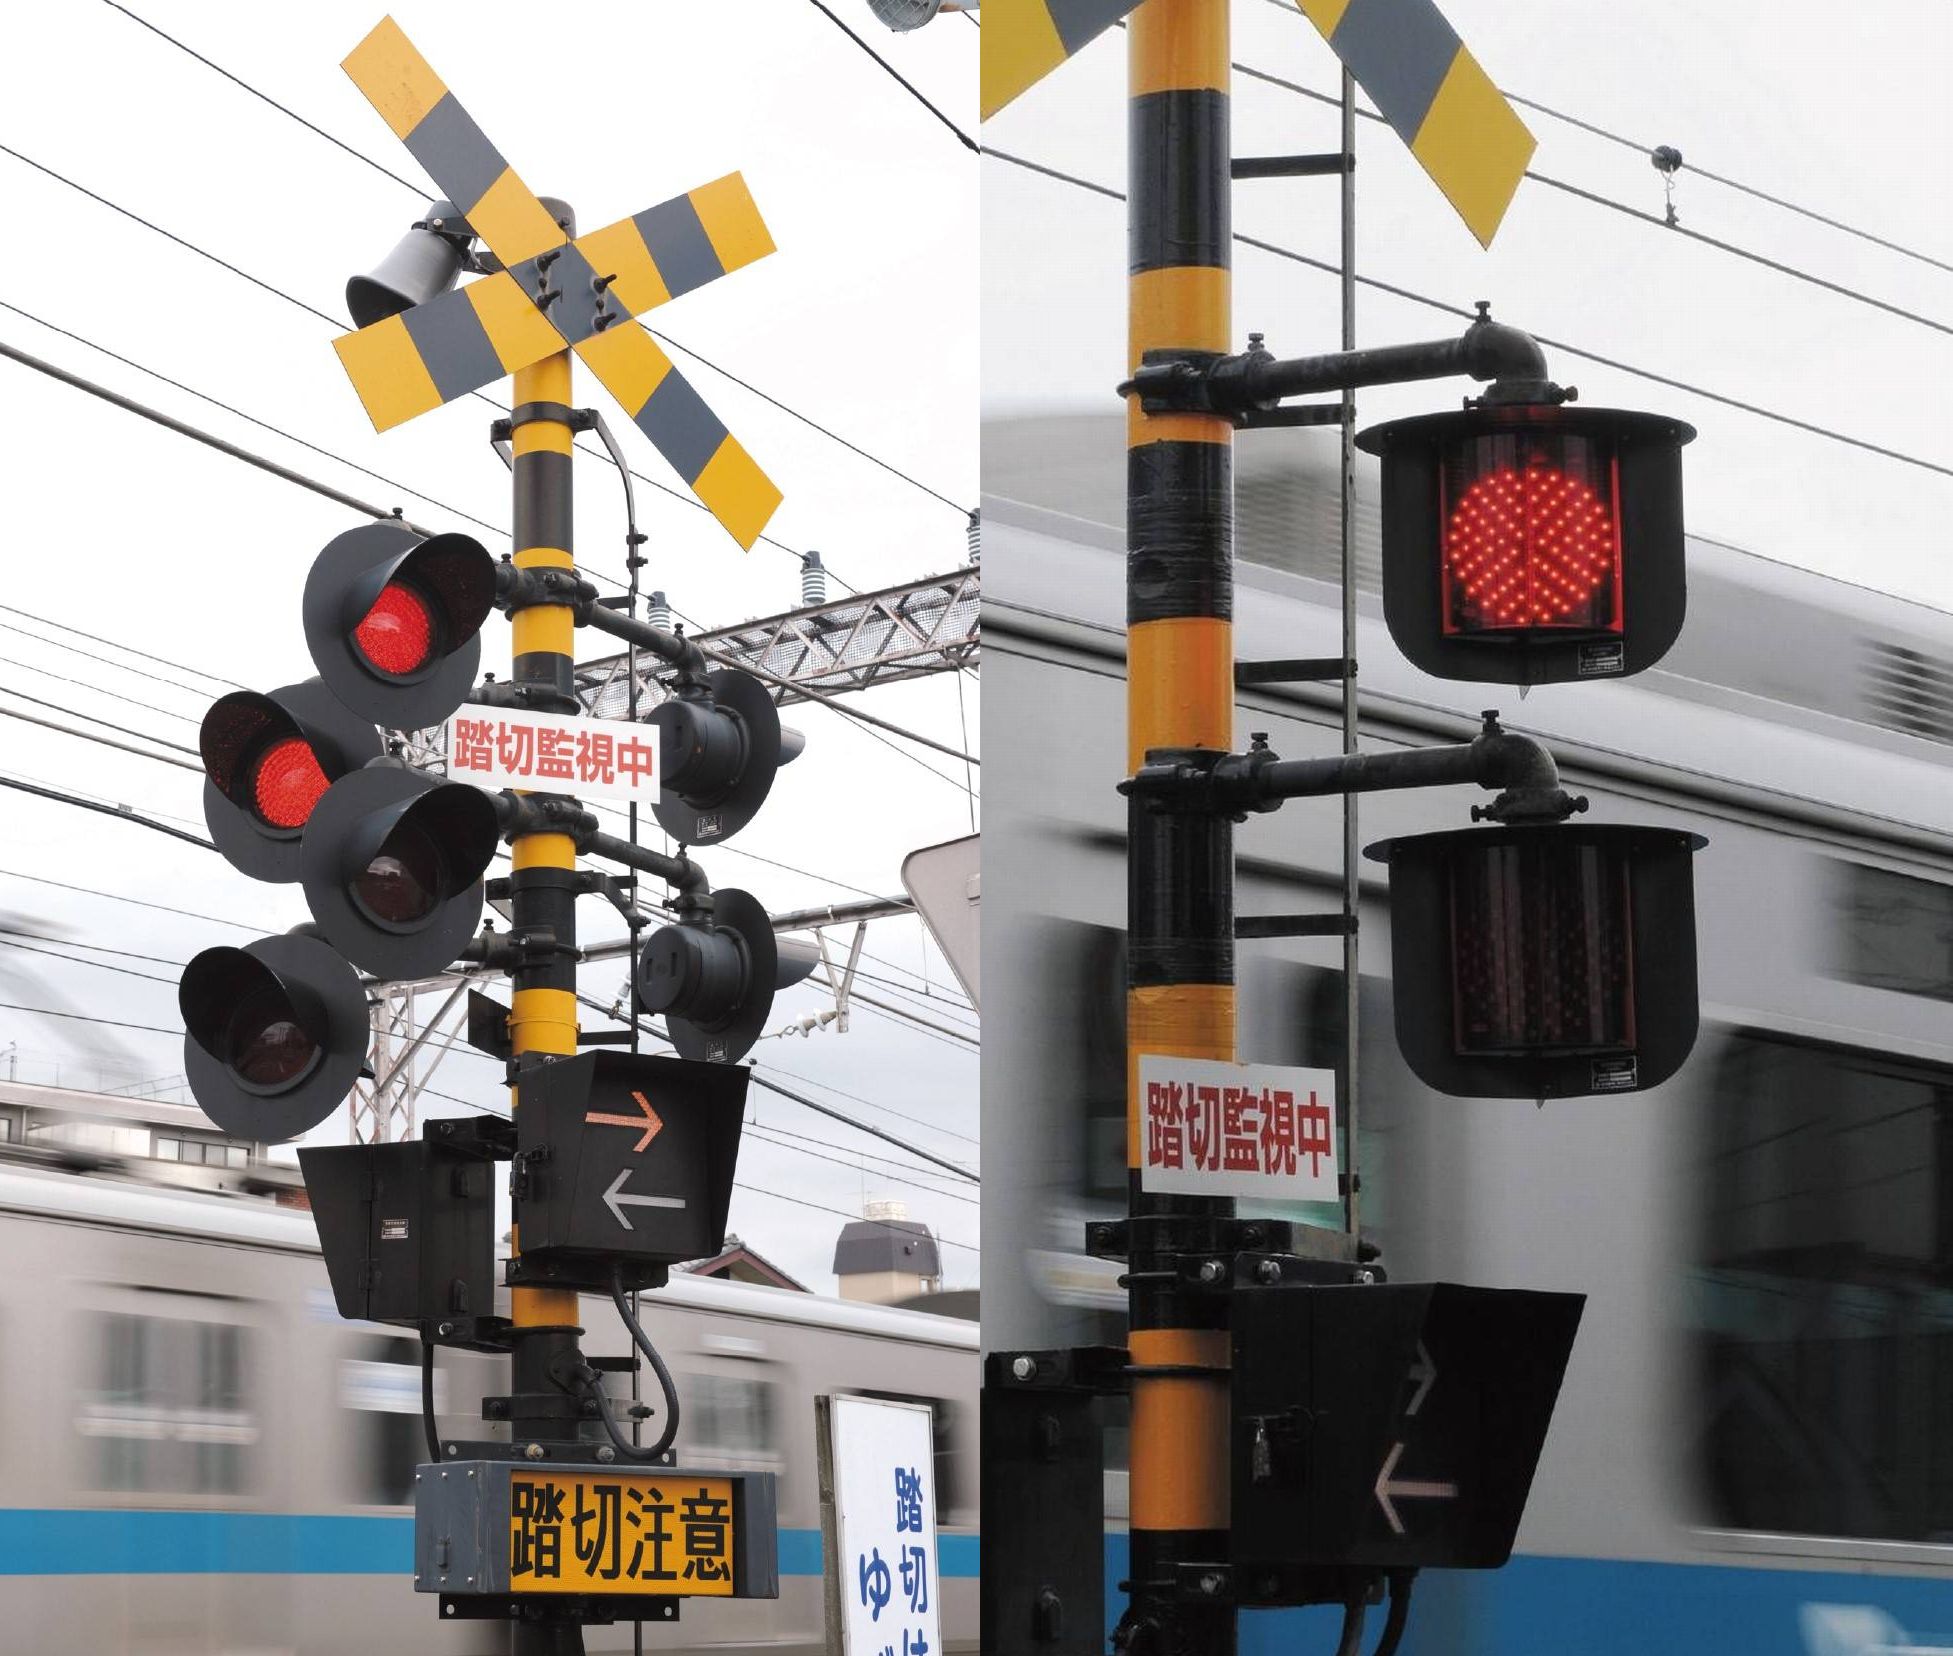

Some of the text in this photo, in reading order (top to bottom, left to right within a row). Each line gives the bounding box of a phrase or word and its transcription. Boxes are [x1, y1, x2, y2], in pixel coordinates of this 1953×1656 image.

[454, 719, 653, 787] 踏切監視中
[1147, 1081, 1331, 1178] 踏切監視中
[511, 1482, 731, 1581] 踏切注意
[859, 1546, 894, 1656] ゆ
